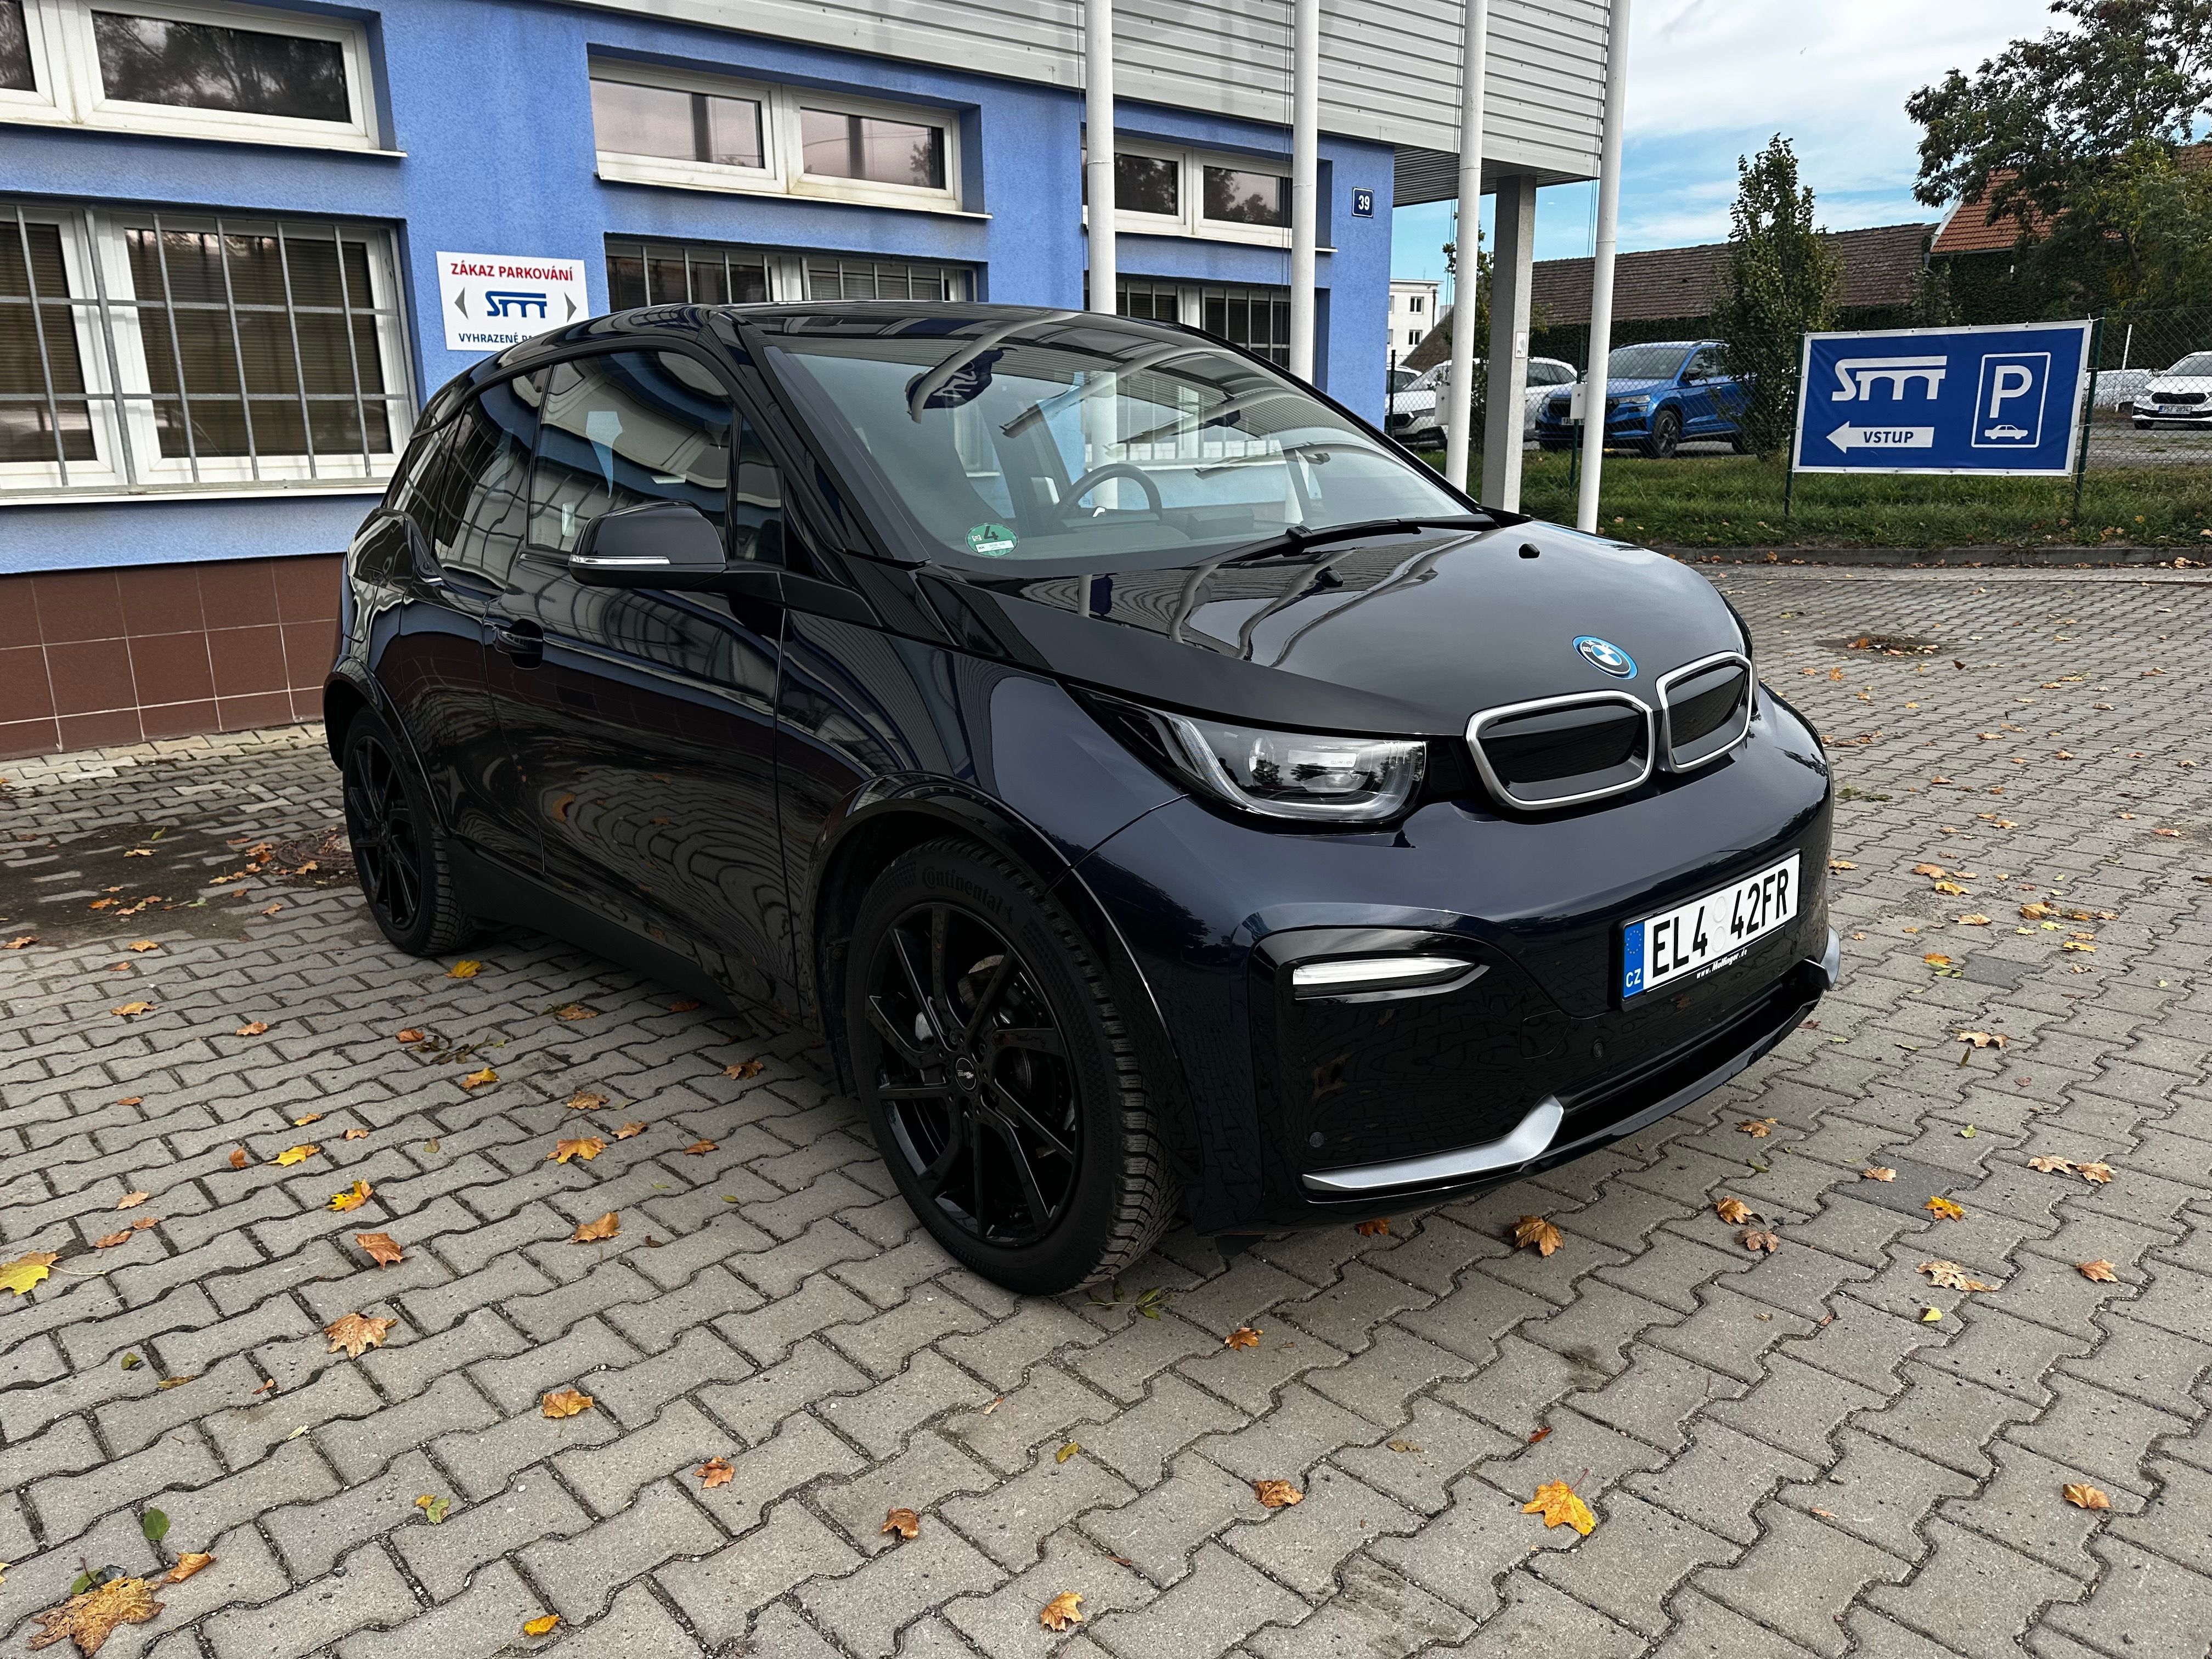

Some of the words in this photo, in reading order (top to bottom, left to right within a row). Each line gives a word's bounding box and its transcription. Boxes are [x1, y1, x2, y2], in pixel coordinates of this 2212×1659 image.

[1358, 195, 1370, 211] 39
[450, 259, 495, 277] ZÁKAZ
[499, 266, 573, 281] PARKOVÁNÍ
[458, 332, 518, 343] VYHRAZENÉ
[1989, 365, 2032, 418] P
[1863, 431, 1914, 444] VSTUP
[984, 526, 999, 540] 4
[922, 866, 1004, 915] Continental
[1652, 905, 1708, 978] EL4
[1730, 868, 1789, 940] 42FR
[1626, 968, 1641, 988] CZ
